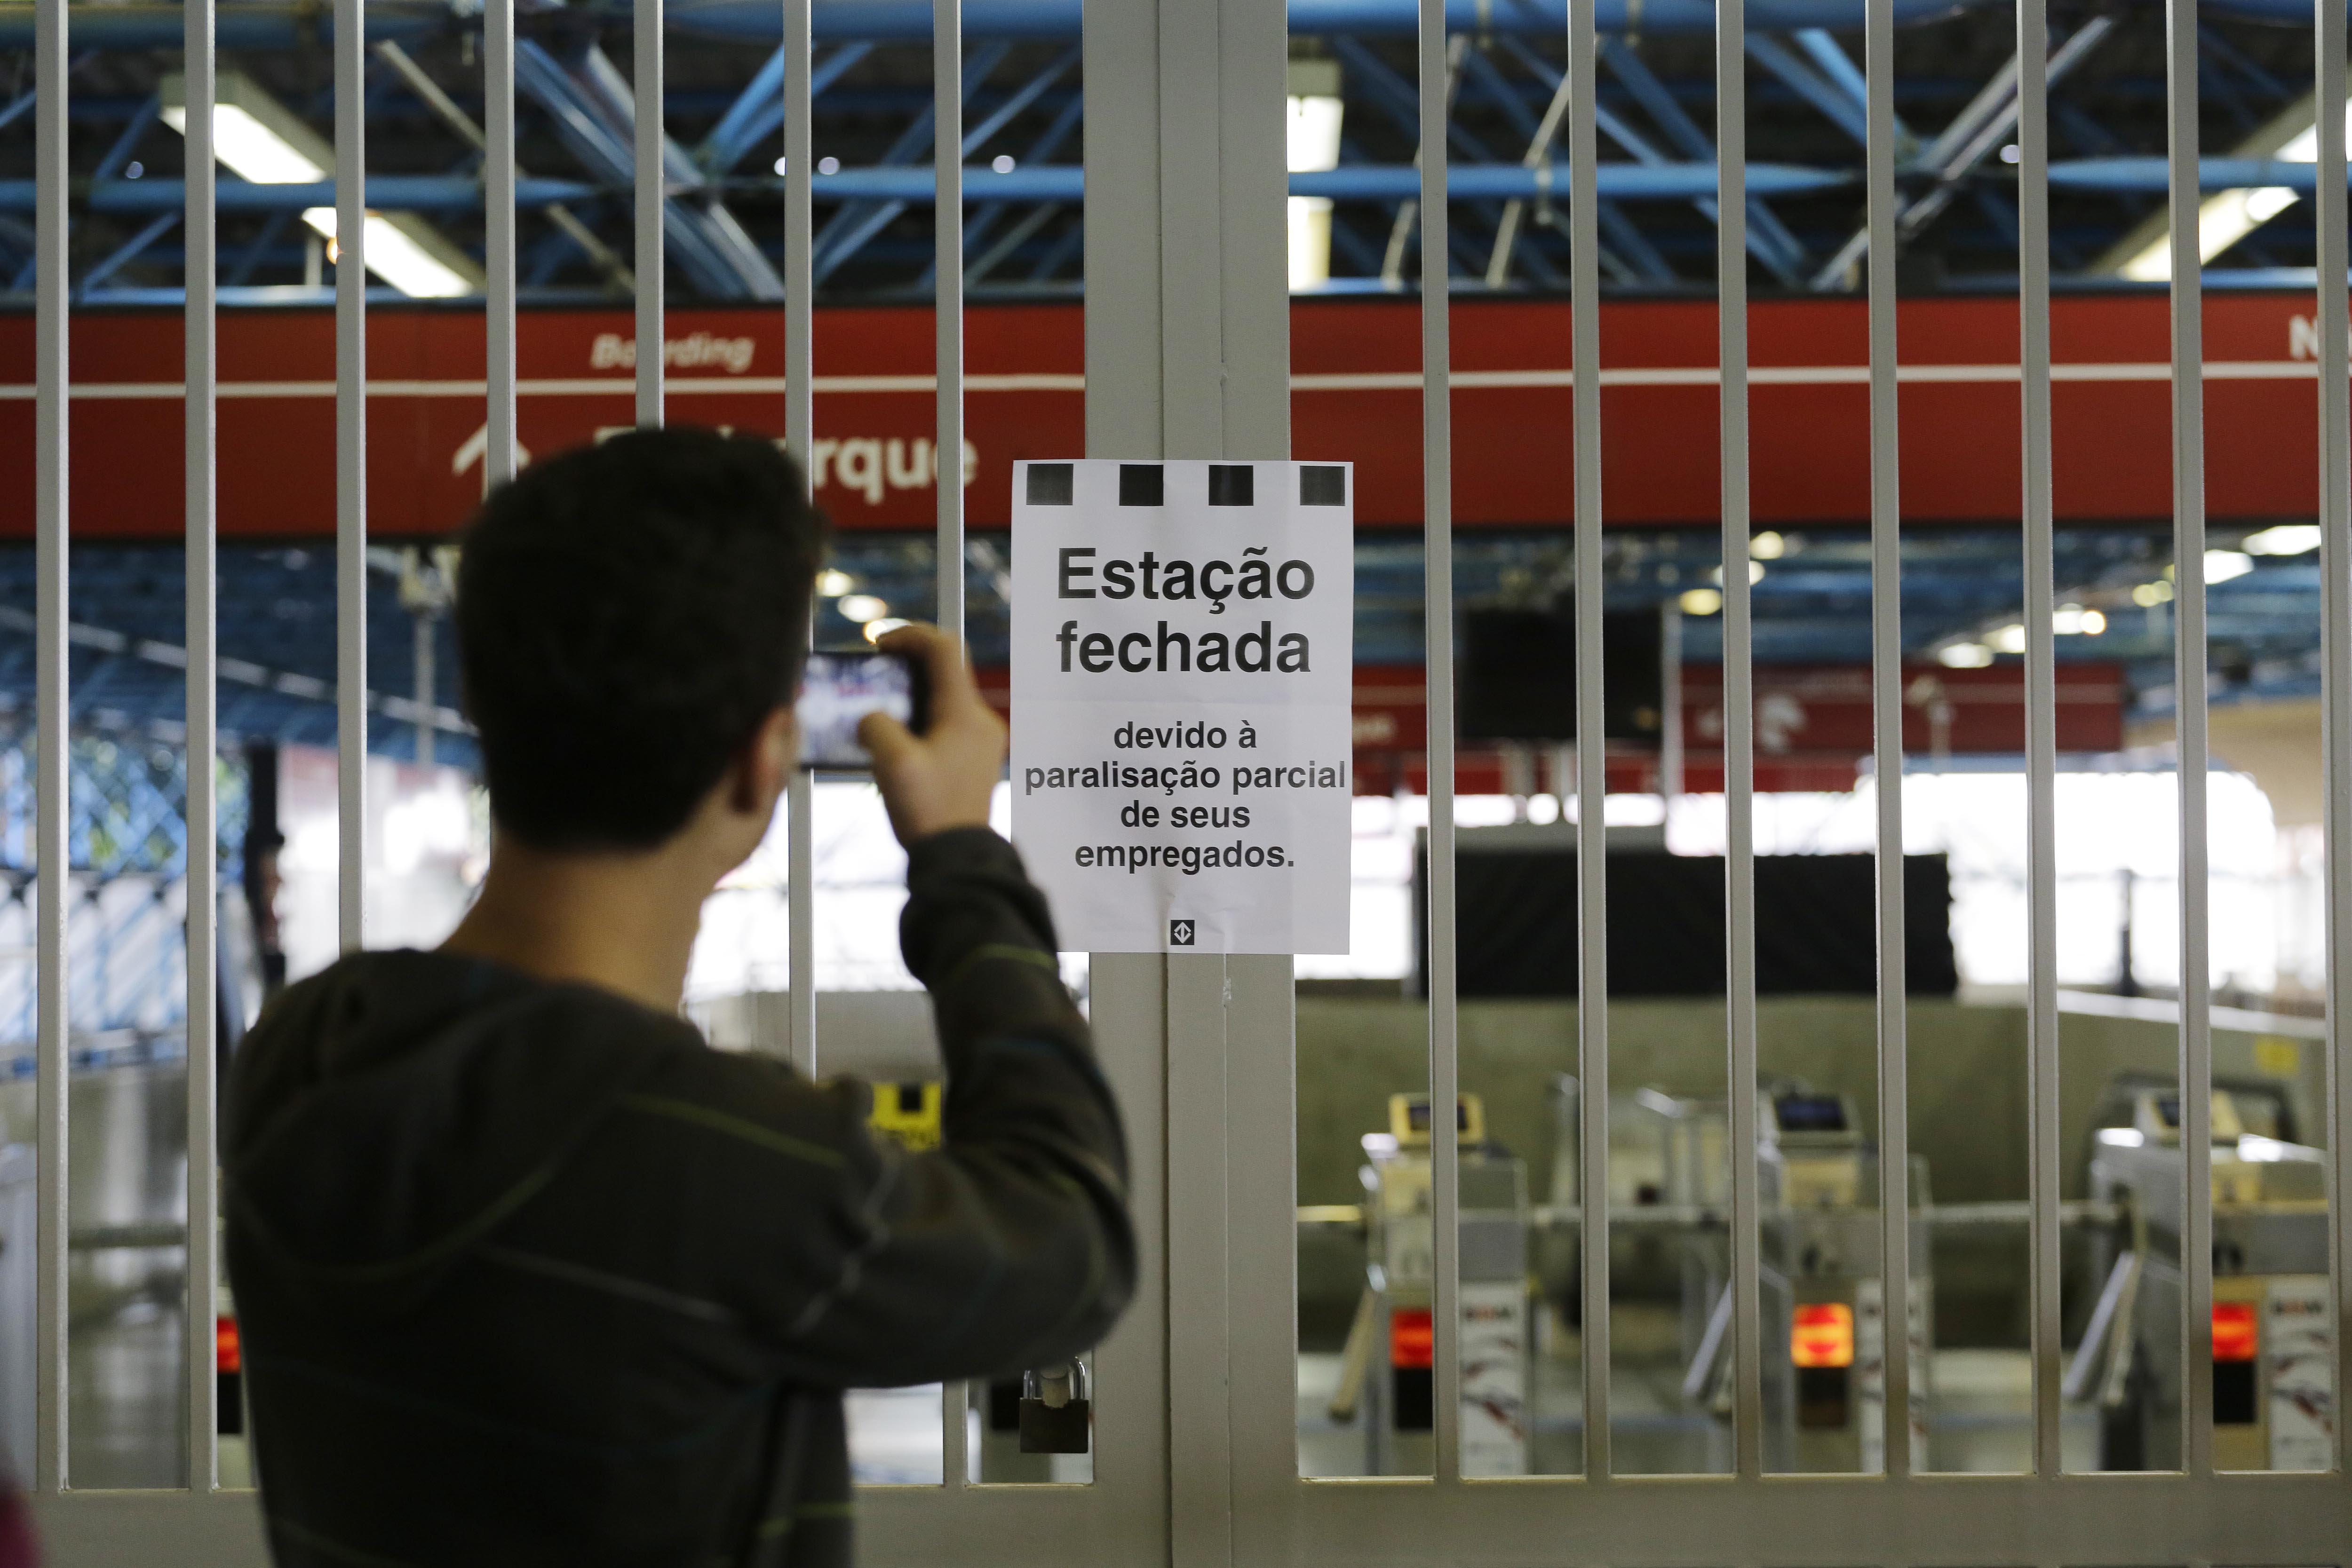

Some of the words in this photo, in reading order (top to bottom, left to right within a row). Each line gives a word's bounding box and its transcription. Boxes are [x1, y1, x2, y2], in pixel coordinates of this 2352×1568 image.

[1058, 546, 1315, 615] Estação
[1056, 620, 1311, 673] fechada
[1114, 721, 1227, 749] devido
[1239, 720, 1256, 749] à
[1025, 760, 1220, 796] paralisação
[1232, 760, 1345, 795] parcial
[1120, 800, 1160, 828] de
[1170, 806, 1250, 828] seus
[1075, 840, 1294, 875] empregados.
